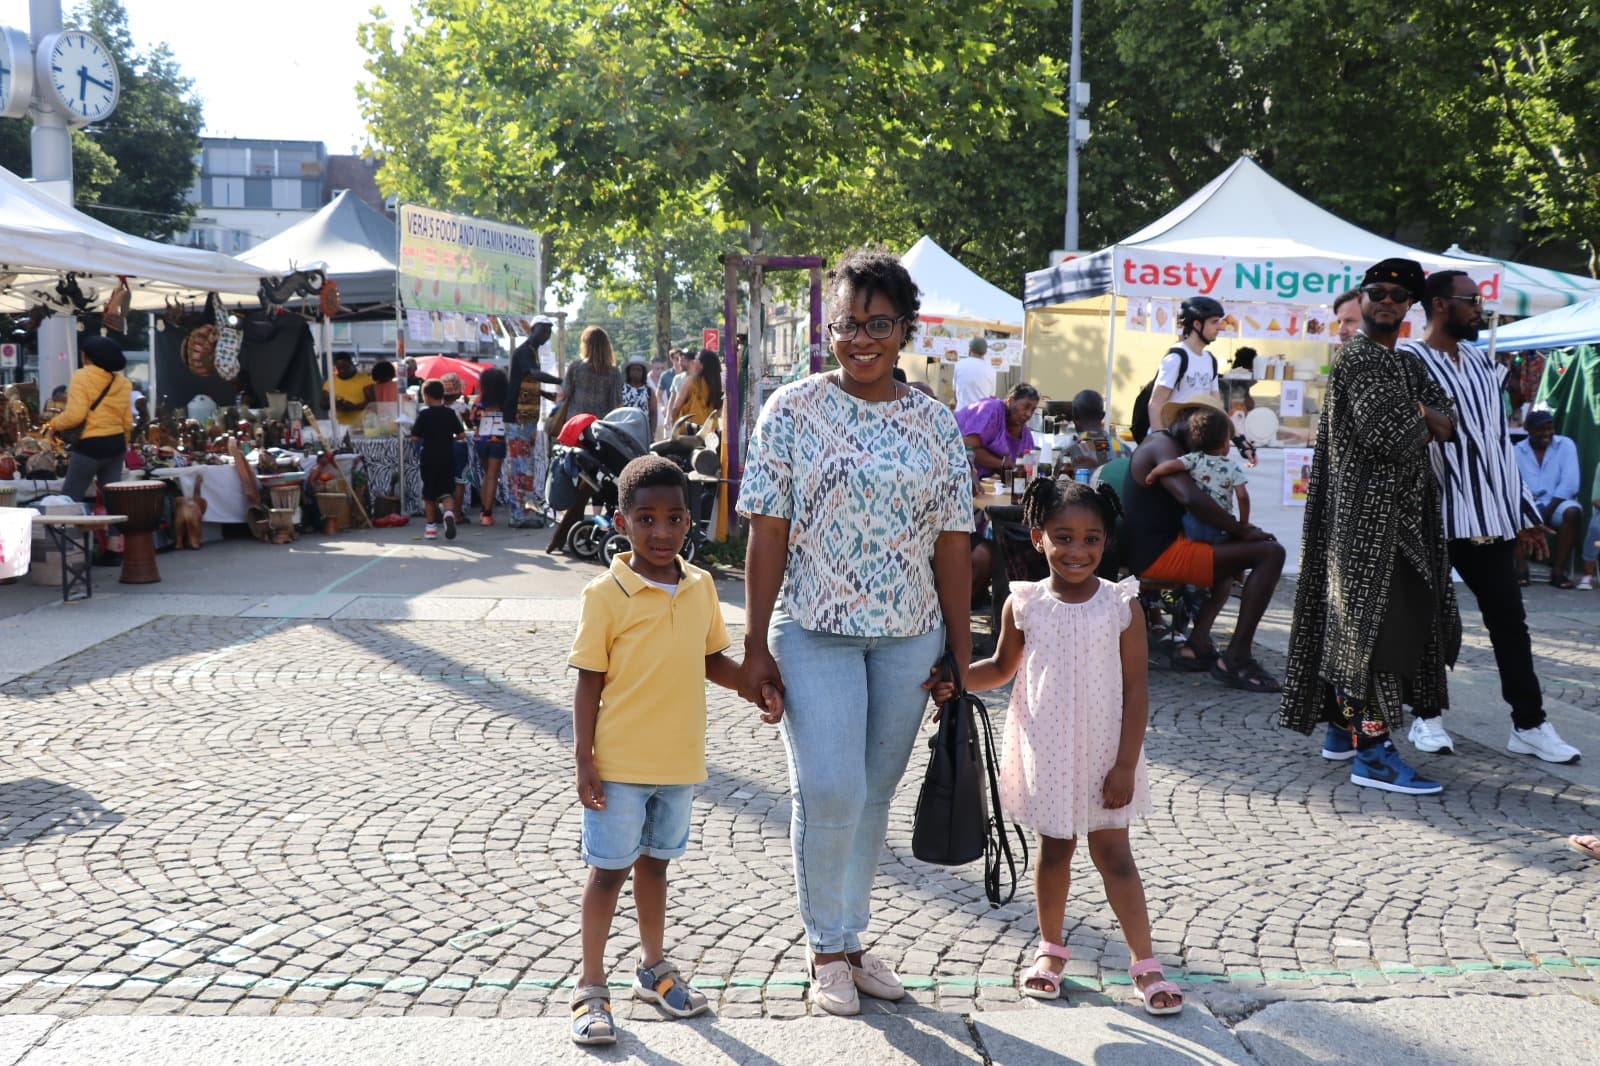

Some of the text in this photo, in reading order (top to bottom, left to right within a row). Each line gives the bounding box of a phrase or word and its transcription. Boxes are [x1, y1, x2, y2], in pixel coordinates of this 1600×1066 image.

[407, 211, 536, 258] VERA'S FOOD AND VITAMIN PARADISE
[1123, 258, 1222, 295] tasty
